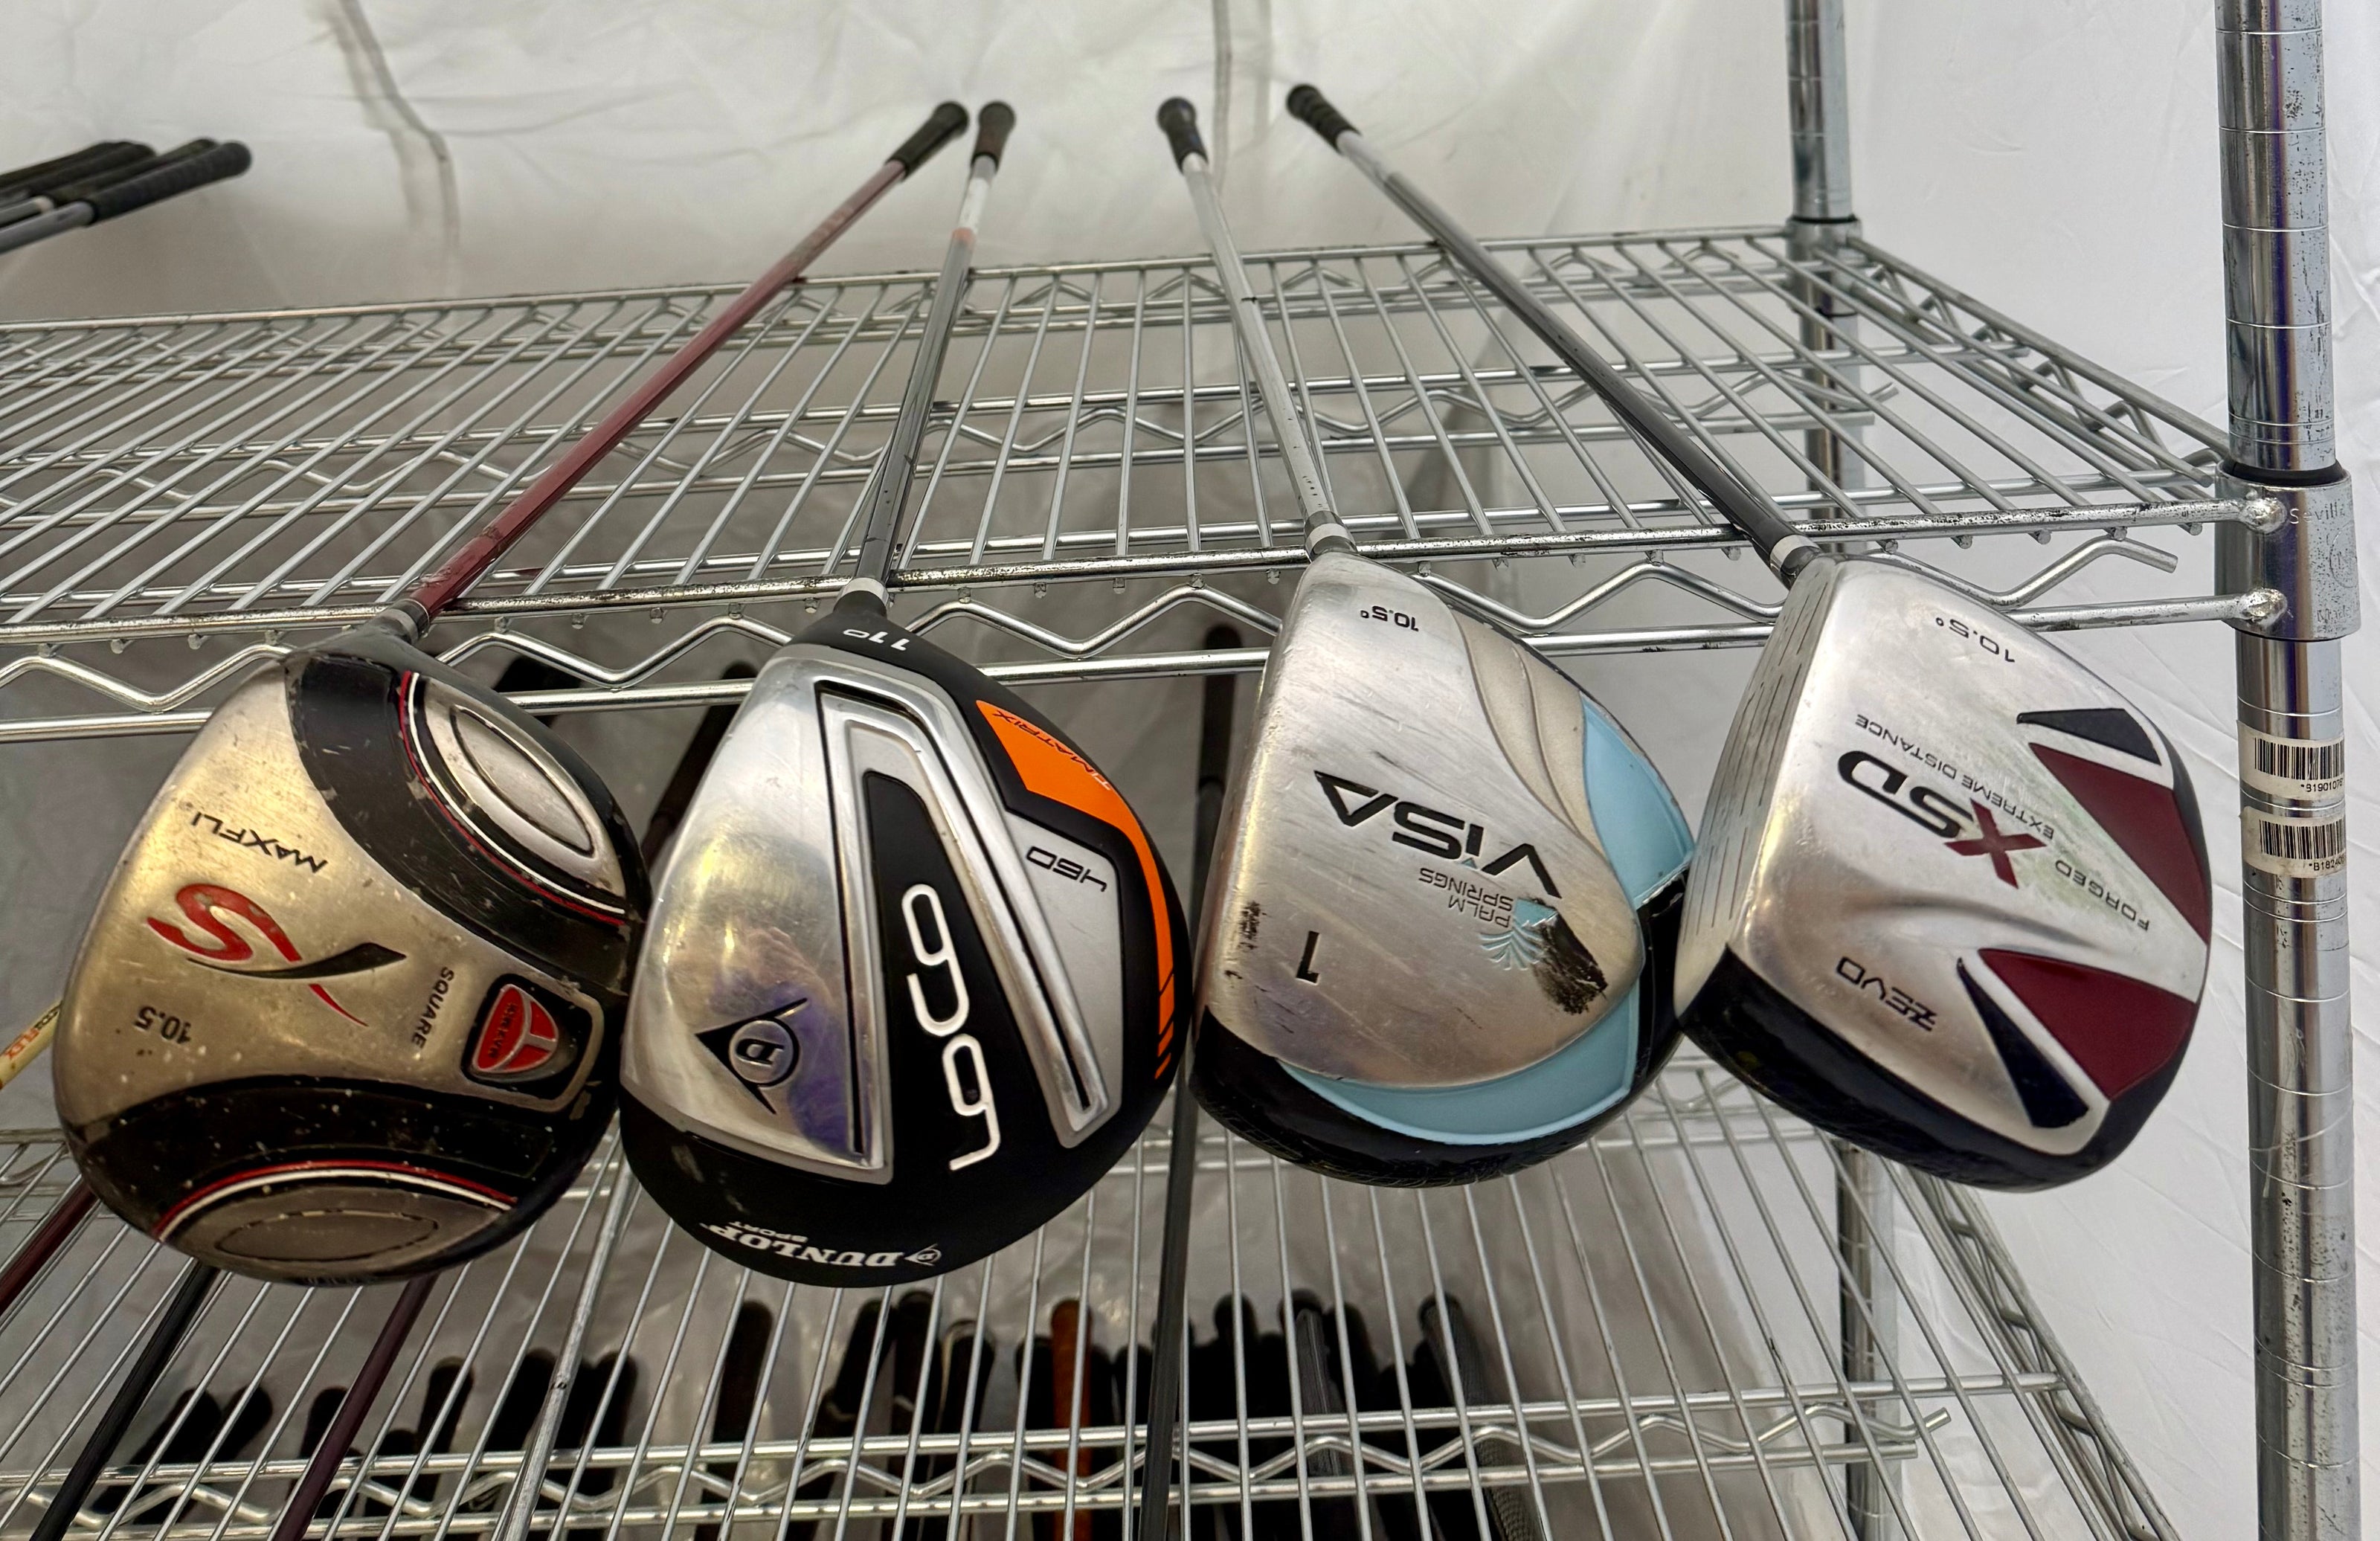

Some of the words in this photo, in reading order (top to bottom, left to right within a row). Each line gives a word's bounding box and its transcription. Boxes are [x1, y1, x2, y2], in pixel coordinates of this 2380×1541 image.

[1855, 713, 1958, 781] DISTANCE
[1836, 750, 2048, 890] XSD
[1961, 776, 2055, 841] EXTREME
[190, 811, 328, 874] MAXFLI
[1026, 846, 1108, 892] 460
[1418, 866, 1514, 913] SPRINGS
[1448, 893, 1512, 929] PALM
[2054, 858, 2151, 931] FORGED
[133, 1005, 193, 1045] 10.5
[411, 966, 455, 1050] SQUARE
[708, 1223, 904, 1267] DUNLOP
[728, 1220, 808, 1244] SPORT
